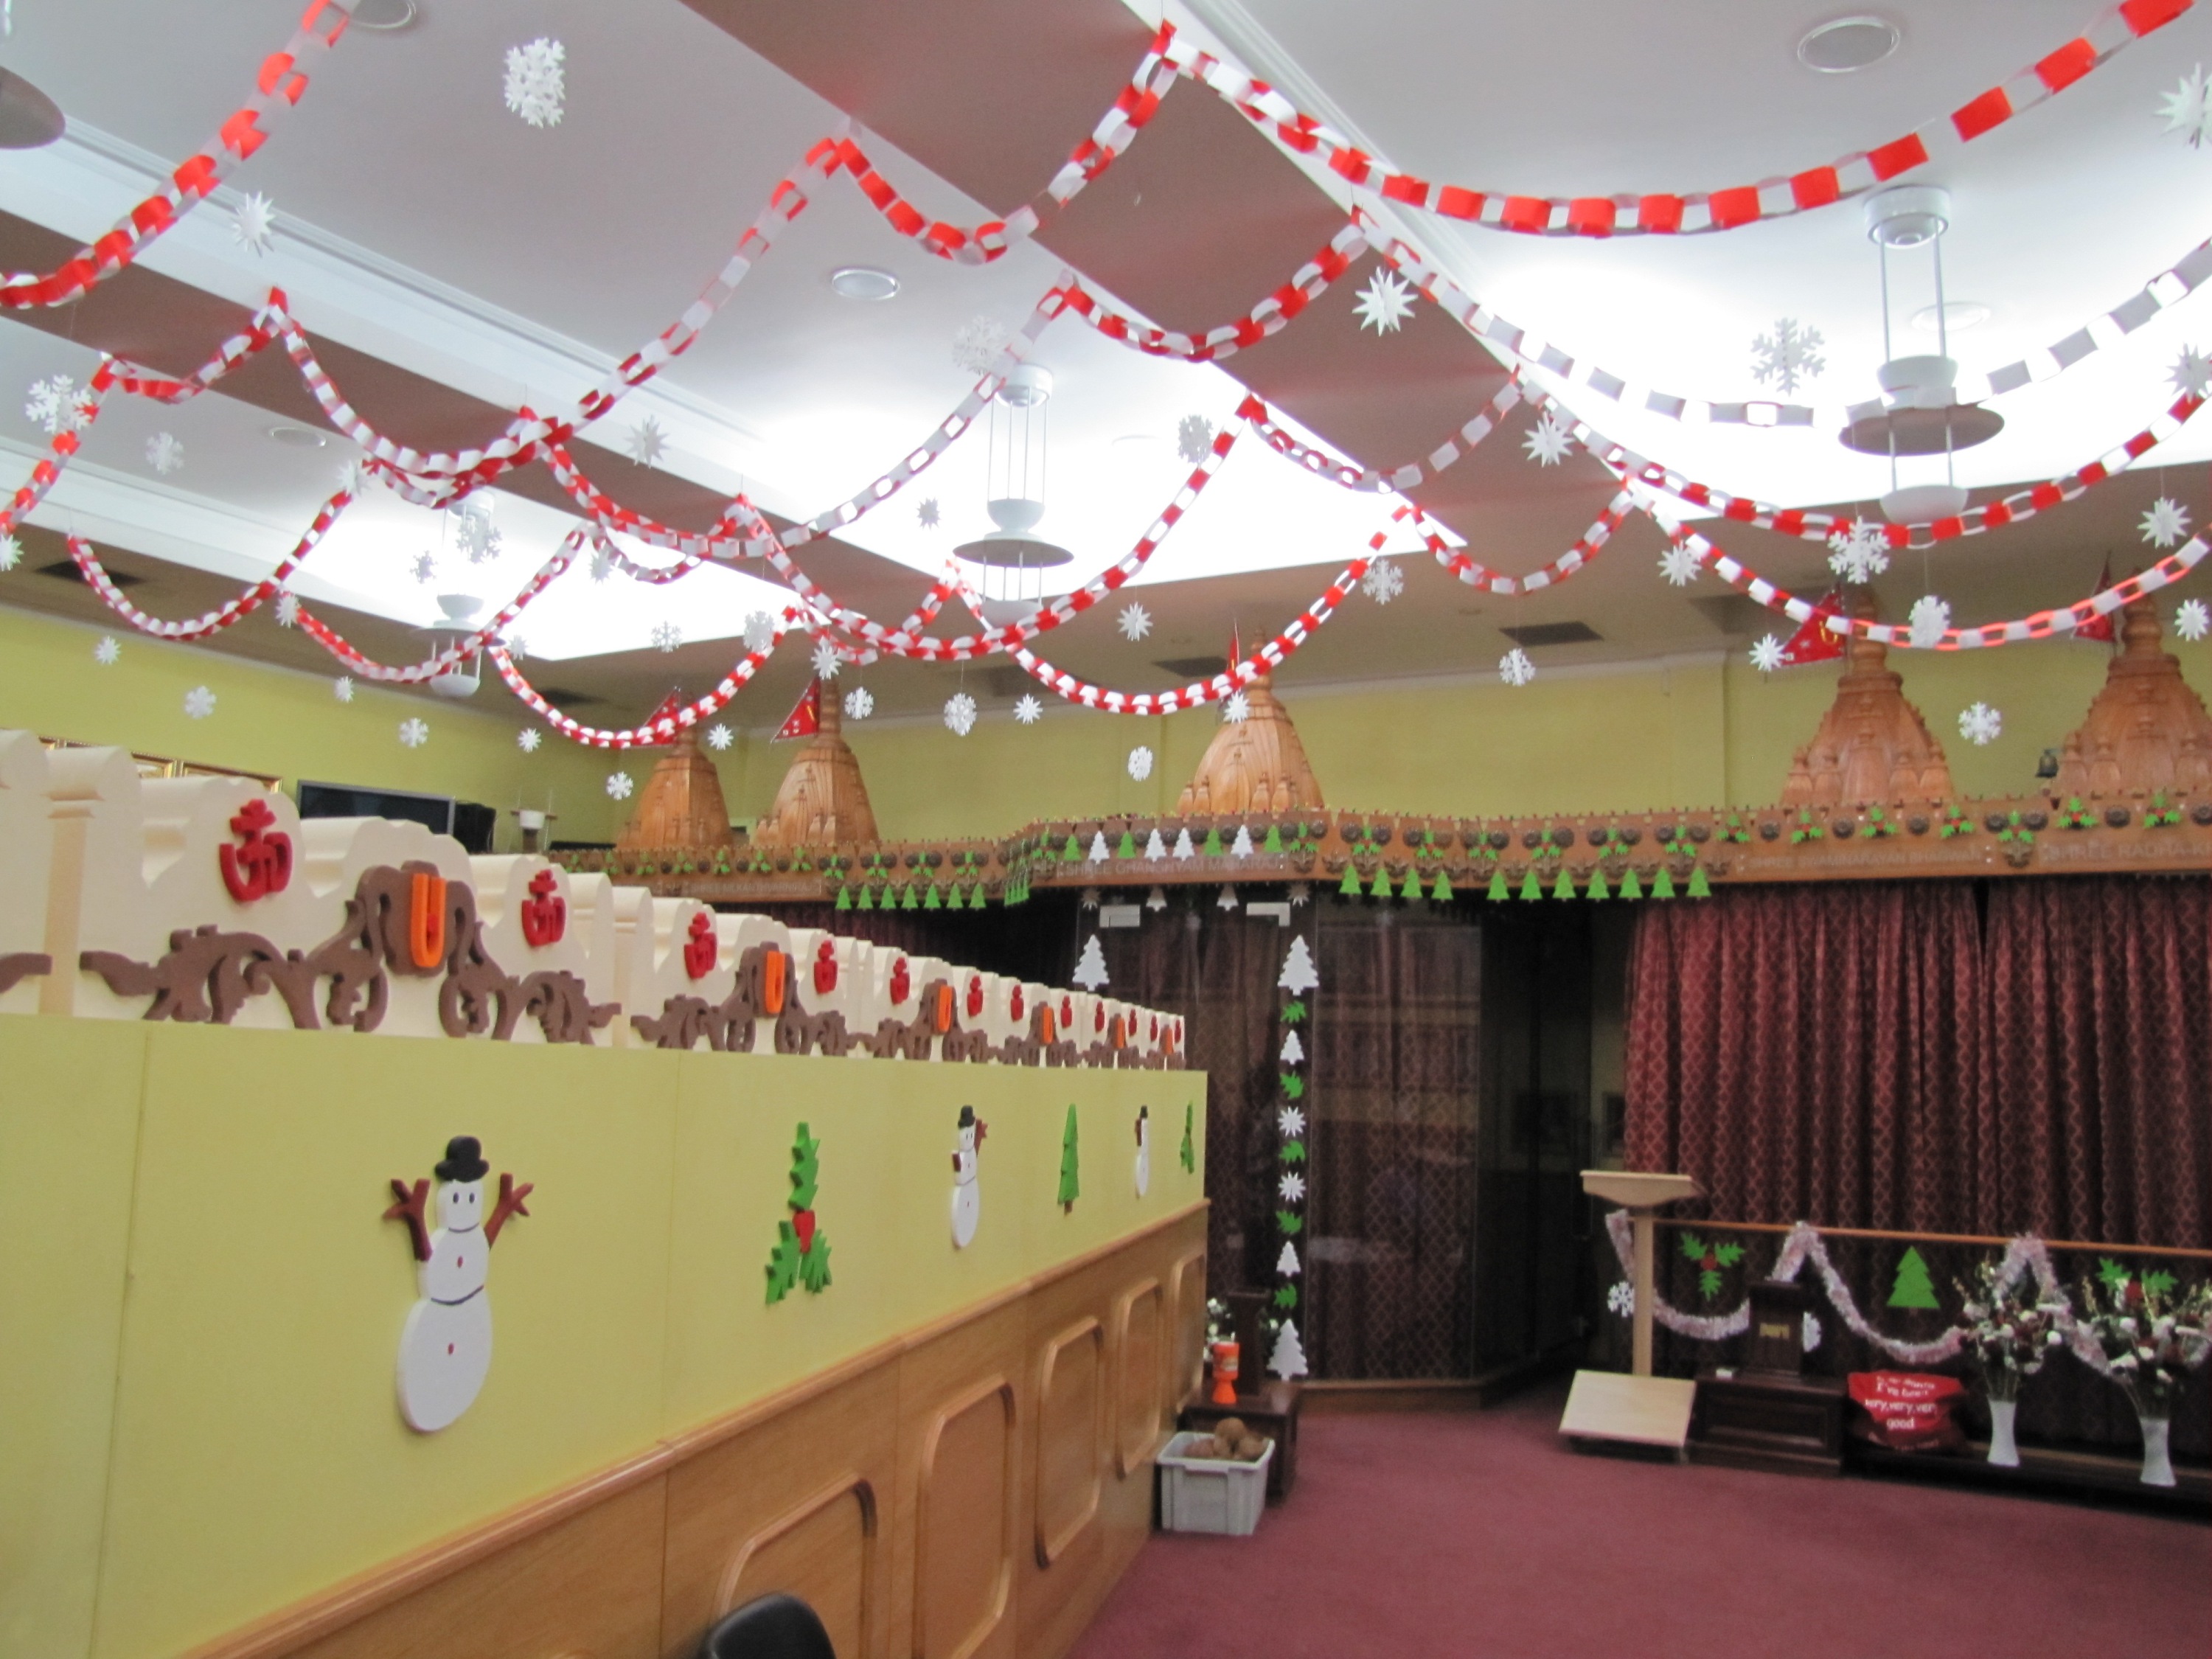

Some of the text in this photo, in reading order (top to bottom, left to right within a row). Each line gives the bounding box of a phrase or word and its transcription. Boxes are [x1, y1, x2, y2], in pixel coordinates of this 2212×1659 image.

[1067, 862, 1112, 875] SHREE
[1116, 859, 1204, 874] GHANSHYAM
[1887, 1417, 1915, 1430] good
